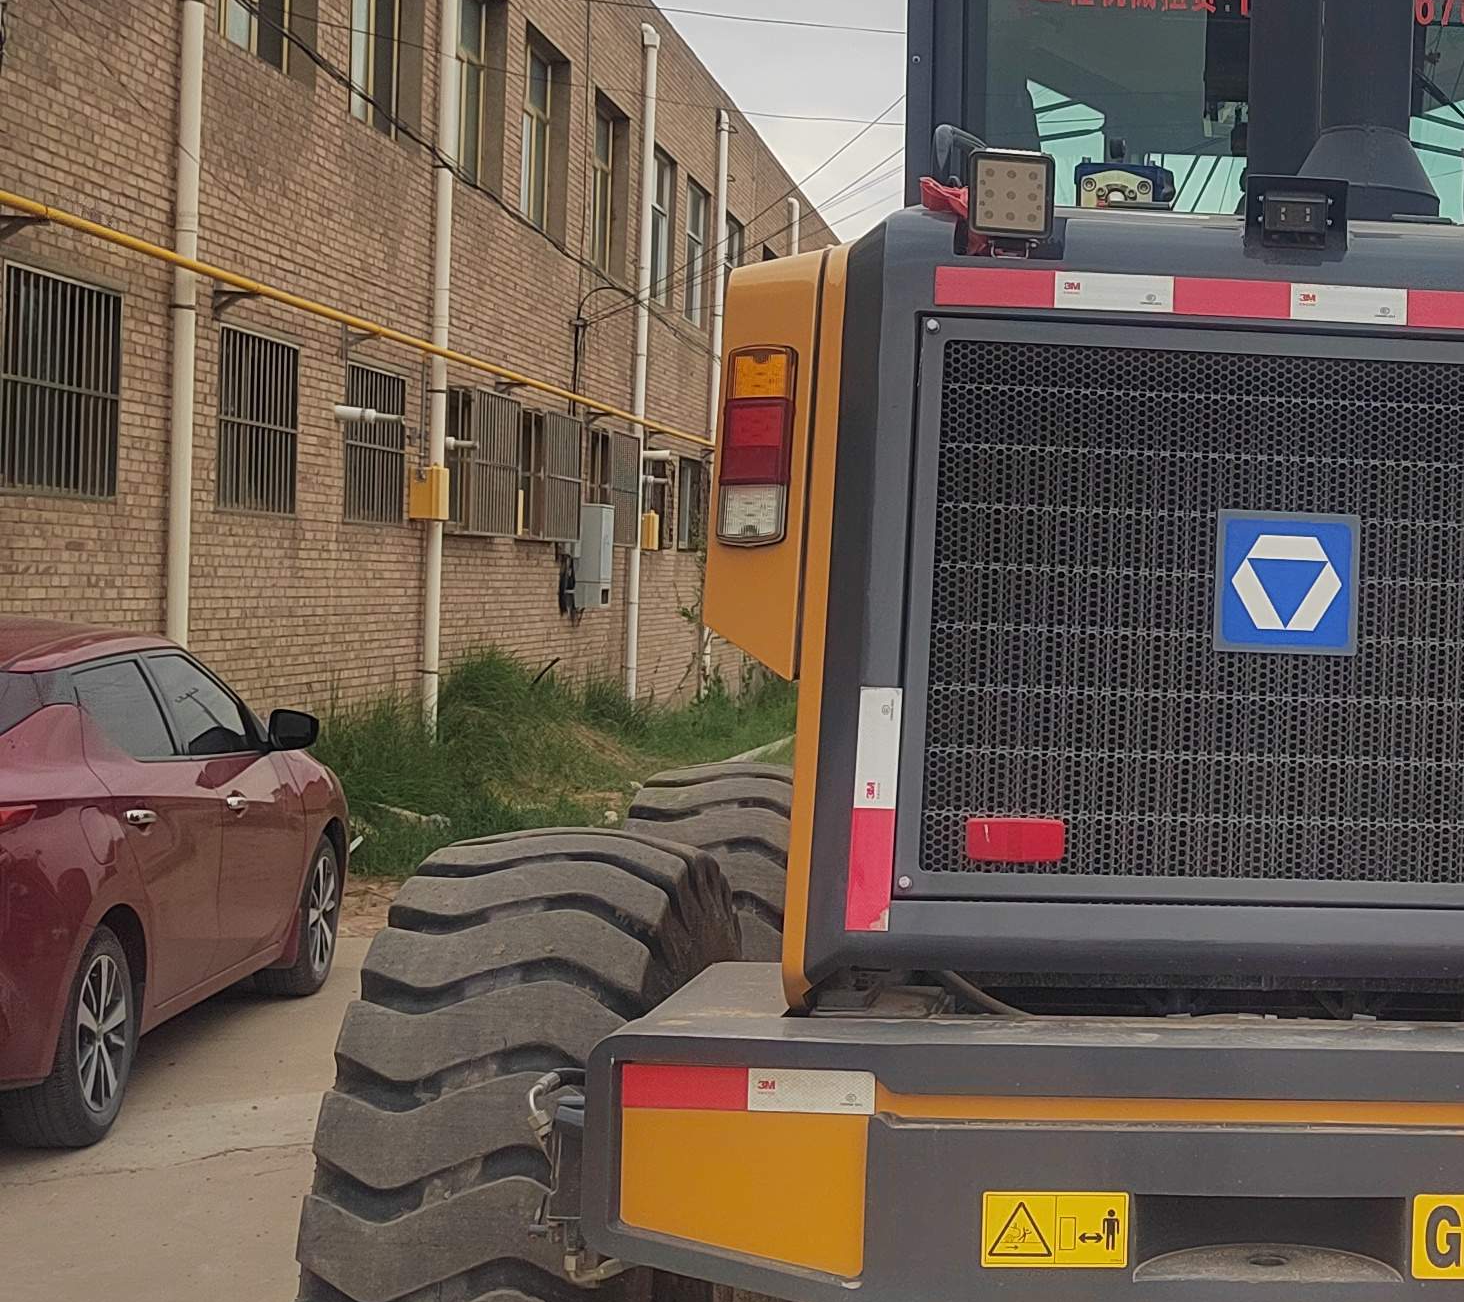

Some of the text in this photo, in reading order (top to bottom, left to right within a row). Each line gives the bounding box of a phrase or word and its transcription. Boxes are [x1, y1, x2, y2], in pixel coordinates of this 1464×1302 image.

[1064, 282, 1080, 291] 3M
[1299, 293, 1316, 302] 3M
[866, 781, 875, 799] 3M
[757, 1080, 776, 1090] 3M
